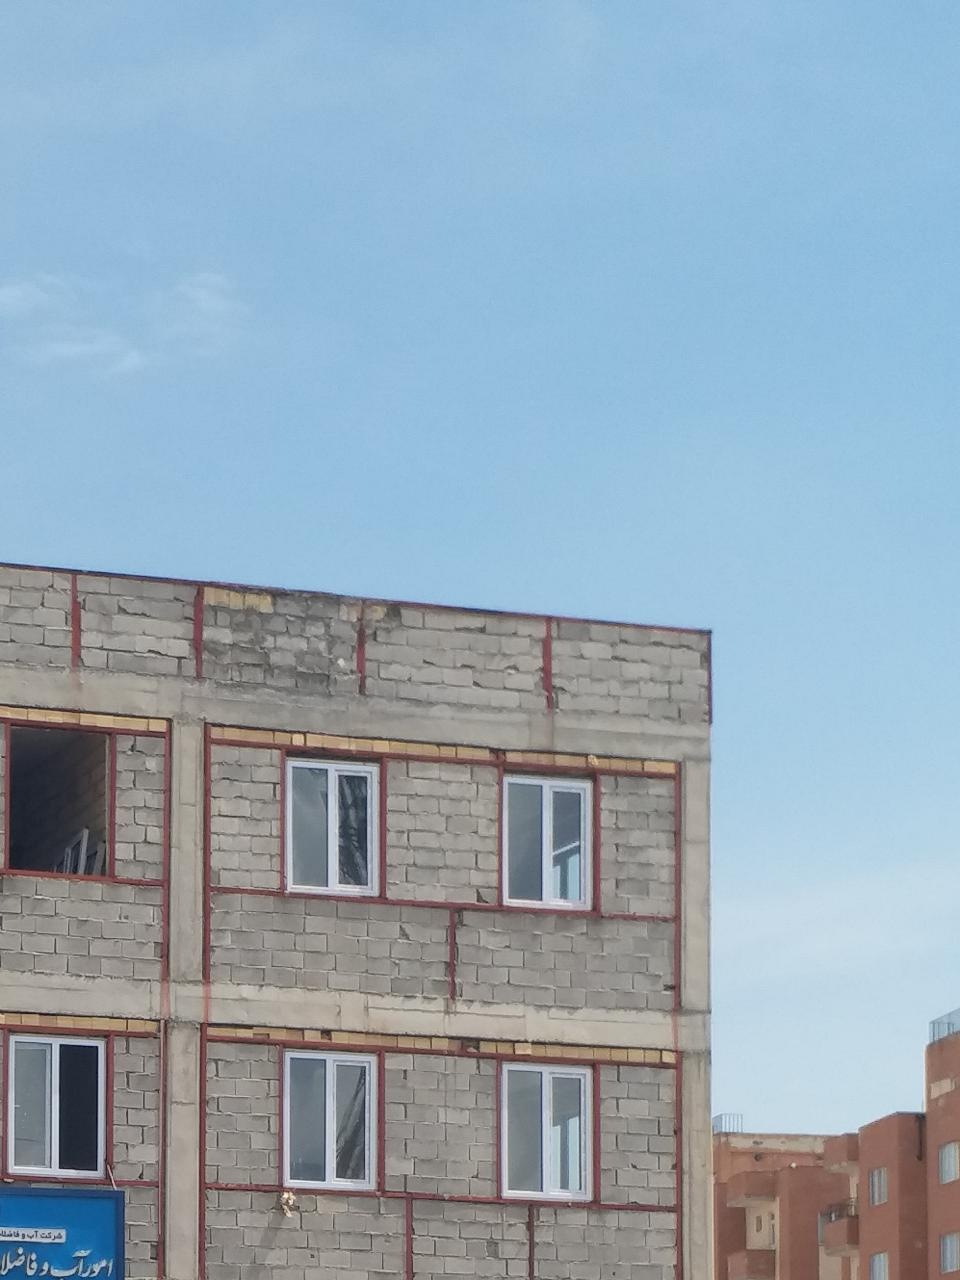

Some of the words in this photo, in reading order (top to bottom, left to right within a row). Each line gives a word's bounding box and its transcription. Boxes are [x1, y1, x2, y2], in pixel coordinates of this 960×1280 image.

[26, 1230, 38, 1240] آب
[40, 1231, 63, 1241] شرکت
[38, 1260, 50, 1276] و
[83, 1258, 113, 1278] امور
